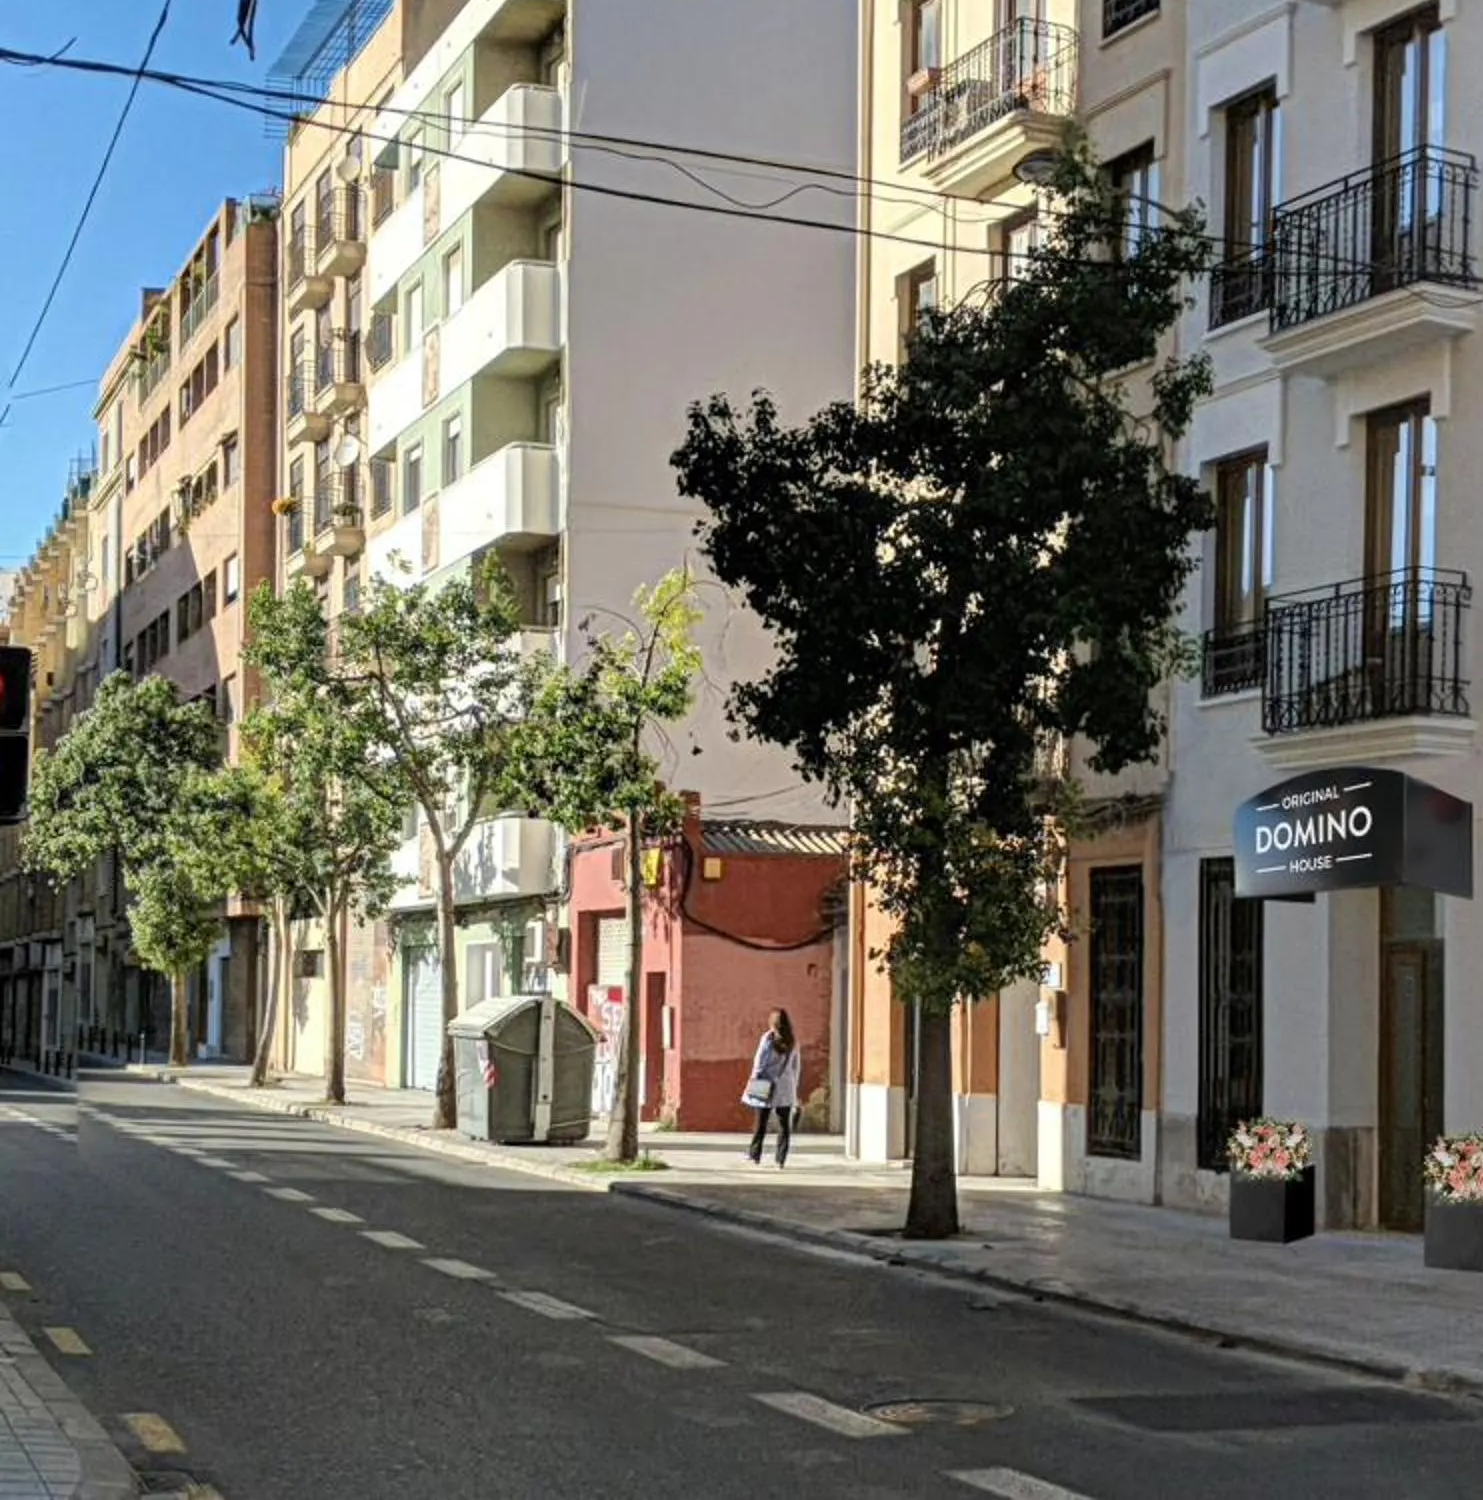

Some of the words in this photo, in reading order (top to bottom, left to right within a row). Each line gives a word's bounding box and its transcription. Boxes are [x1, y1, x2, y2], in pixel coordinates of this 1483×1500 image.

[1281, 785, 1340, 810] ORIGINAL
[1255, 805, 1373, 854] DOMINO
[1289, 854, 1334, 873] HOUSE
